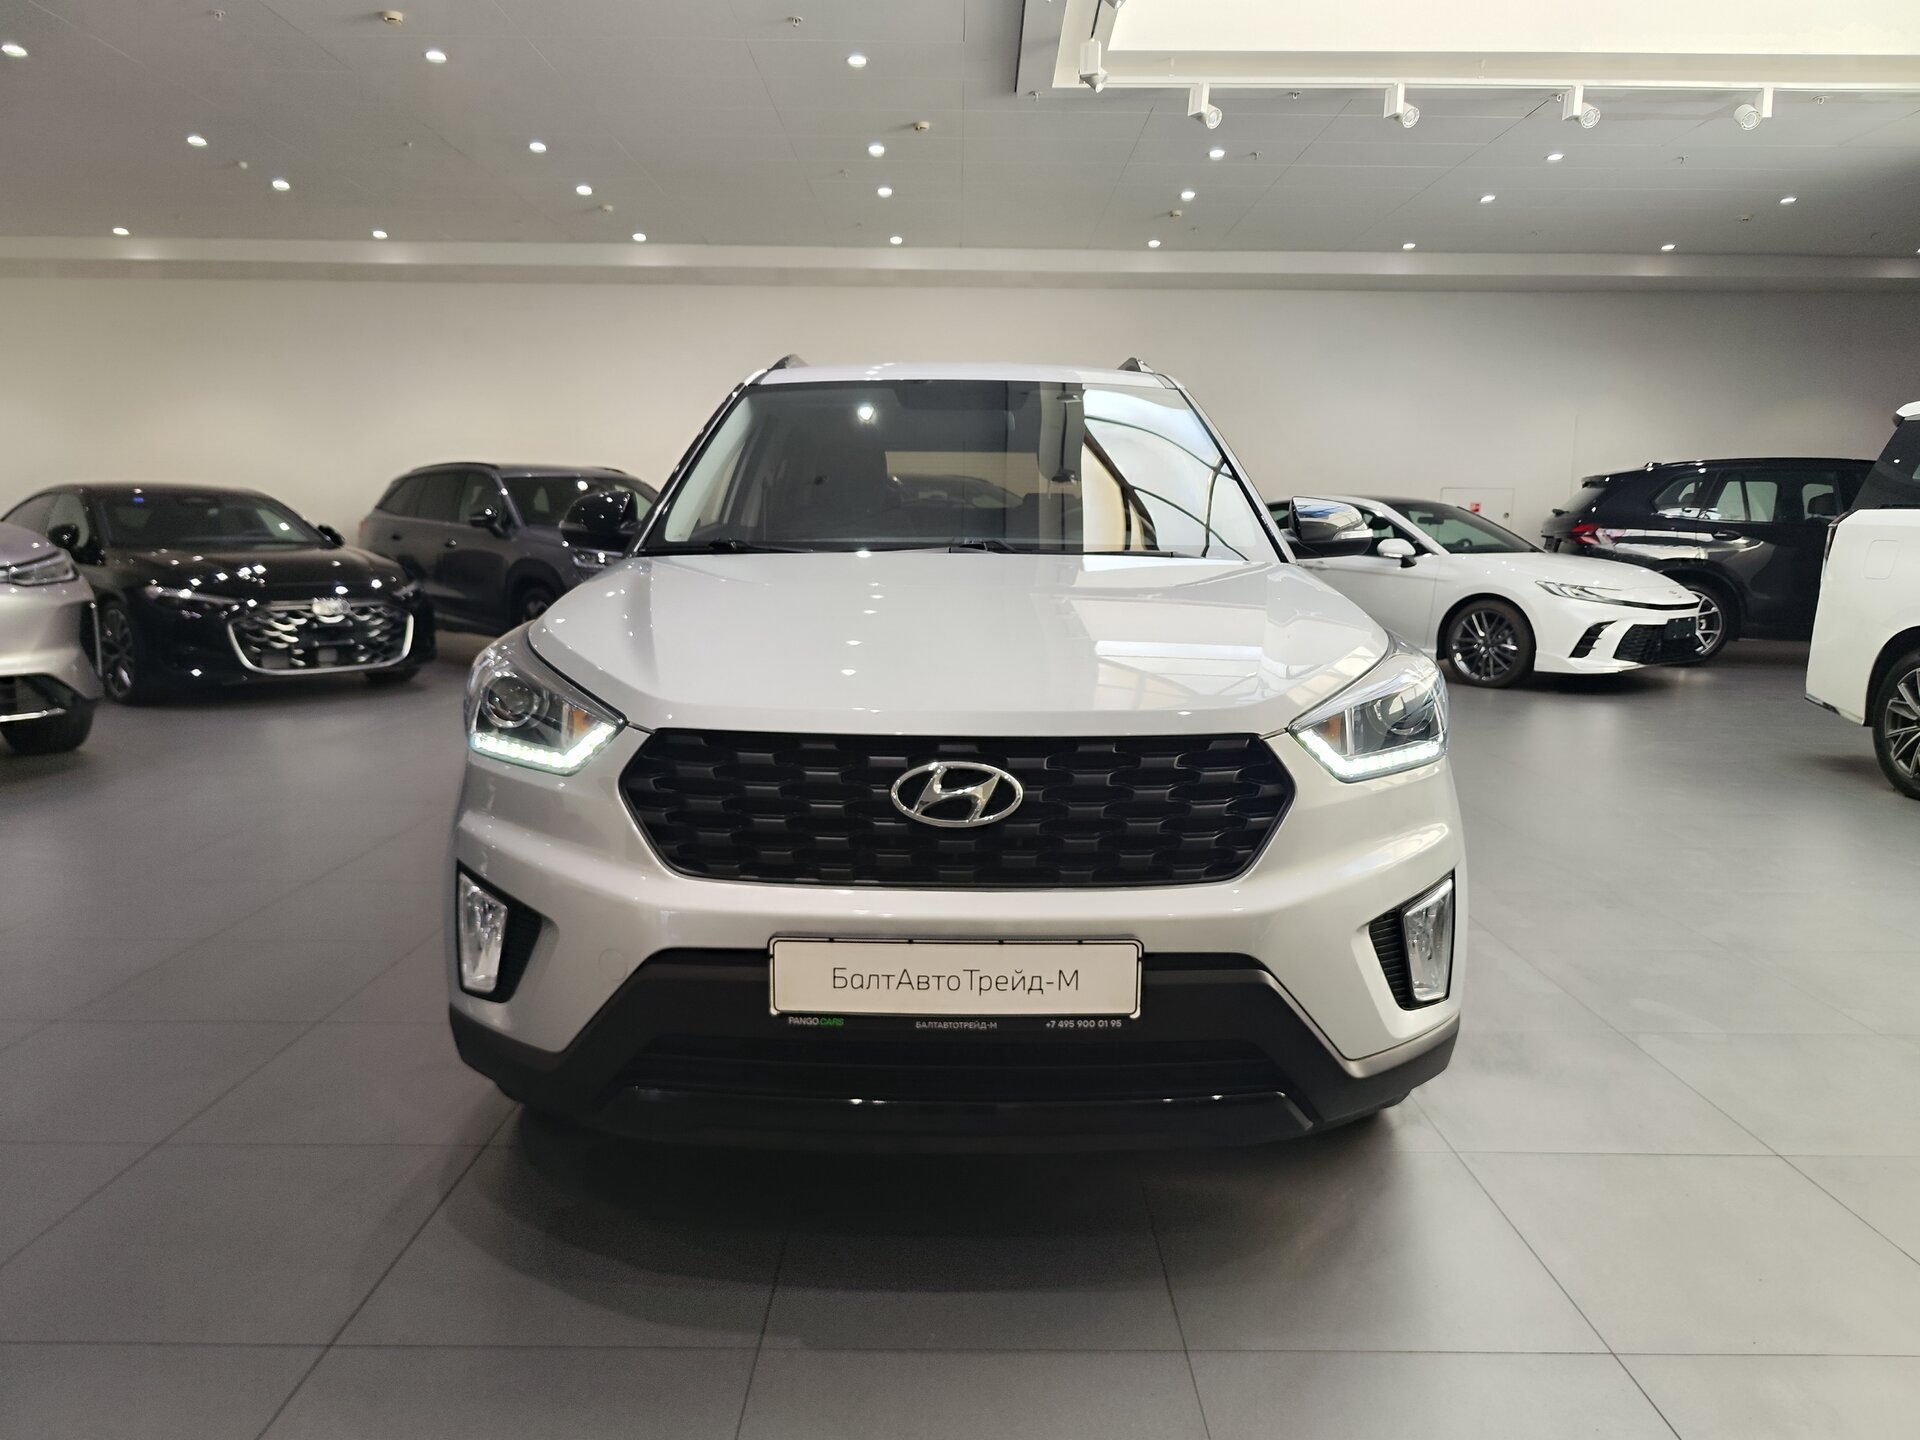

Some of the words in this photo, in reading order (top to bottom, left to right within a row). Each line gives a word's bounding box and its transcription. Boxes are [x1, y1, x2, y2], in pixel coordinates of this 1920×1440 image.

[915, 1020, 998, 1030] БАЛТАВТОТРЕЙД-М
[1045, 1020, 1057, 1028] +7
[1057, 1020, 1075, 1028] 495
[1077, 1020, 1096, 1028] 900
[1097, 1019, 1109, 1028] 01
[1110, 1019, 1123, 1028] 95
